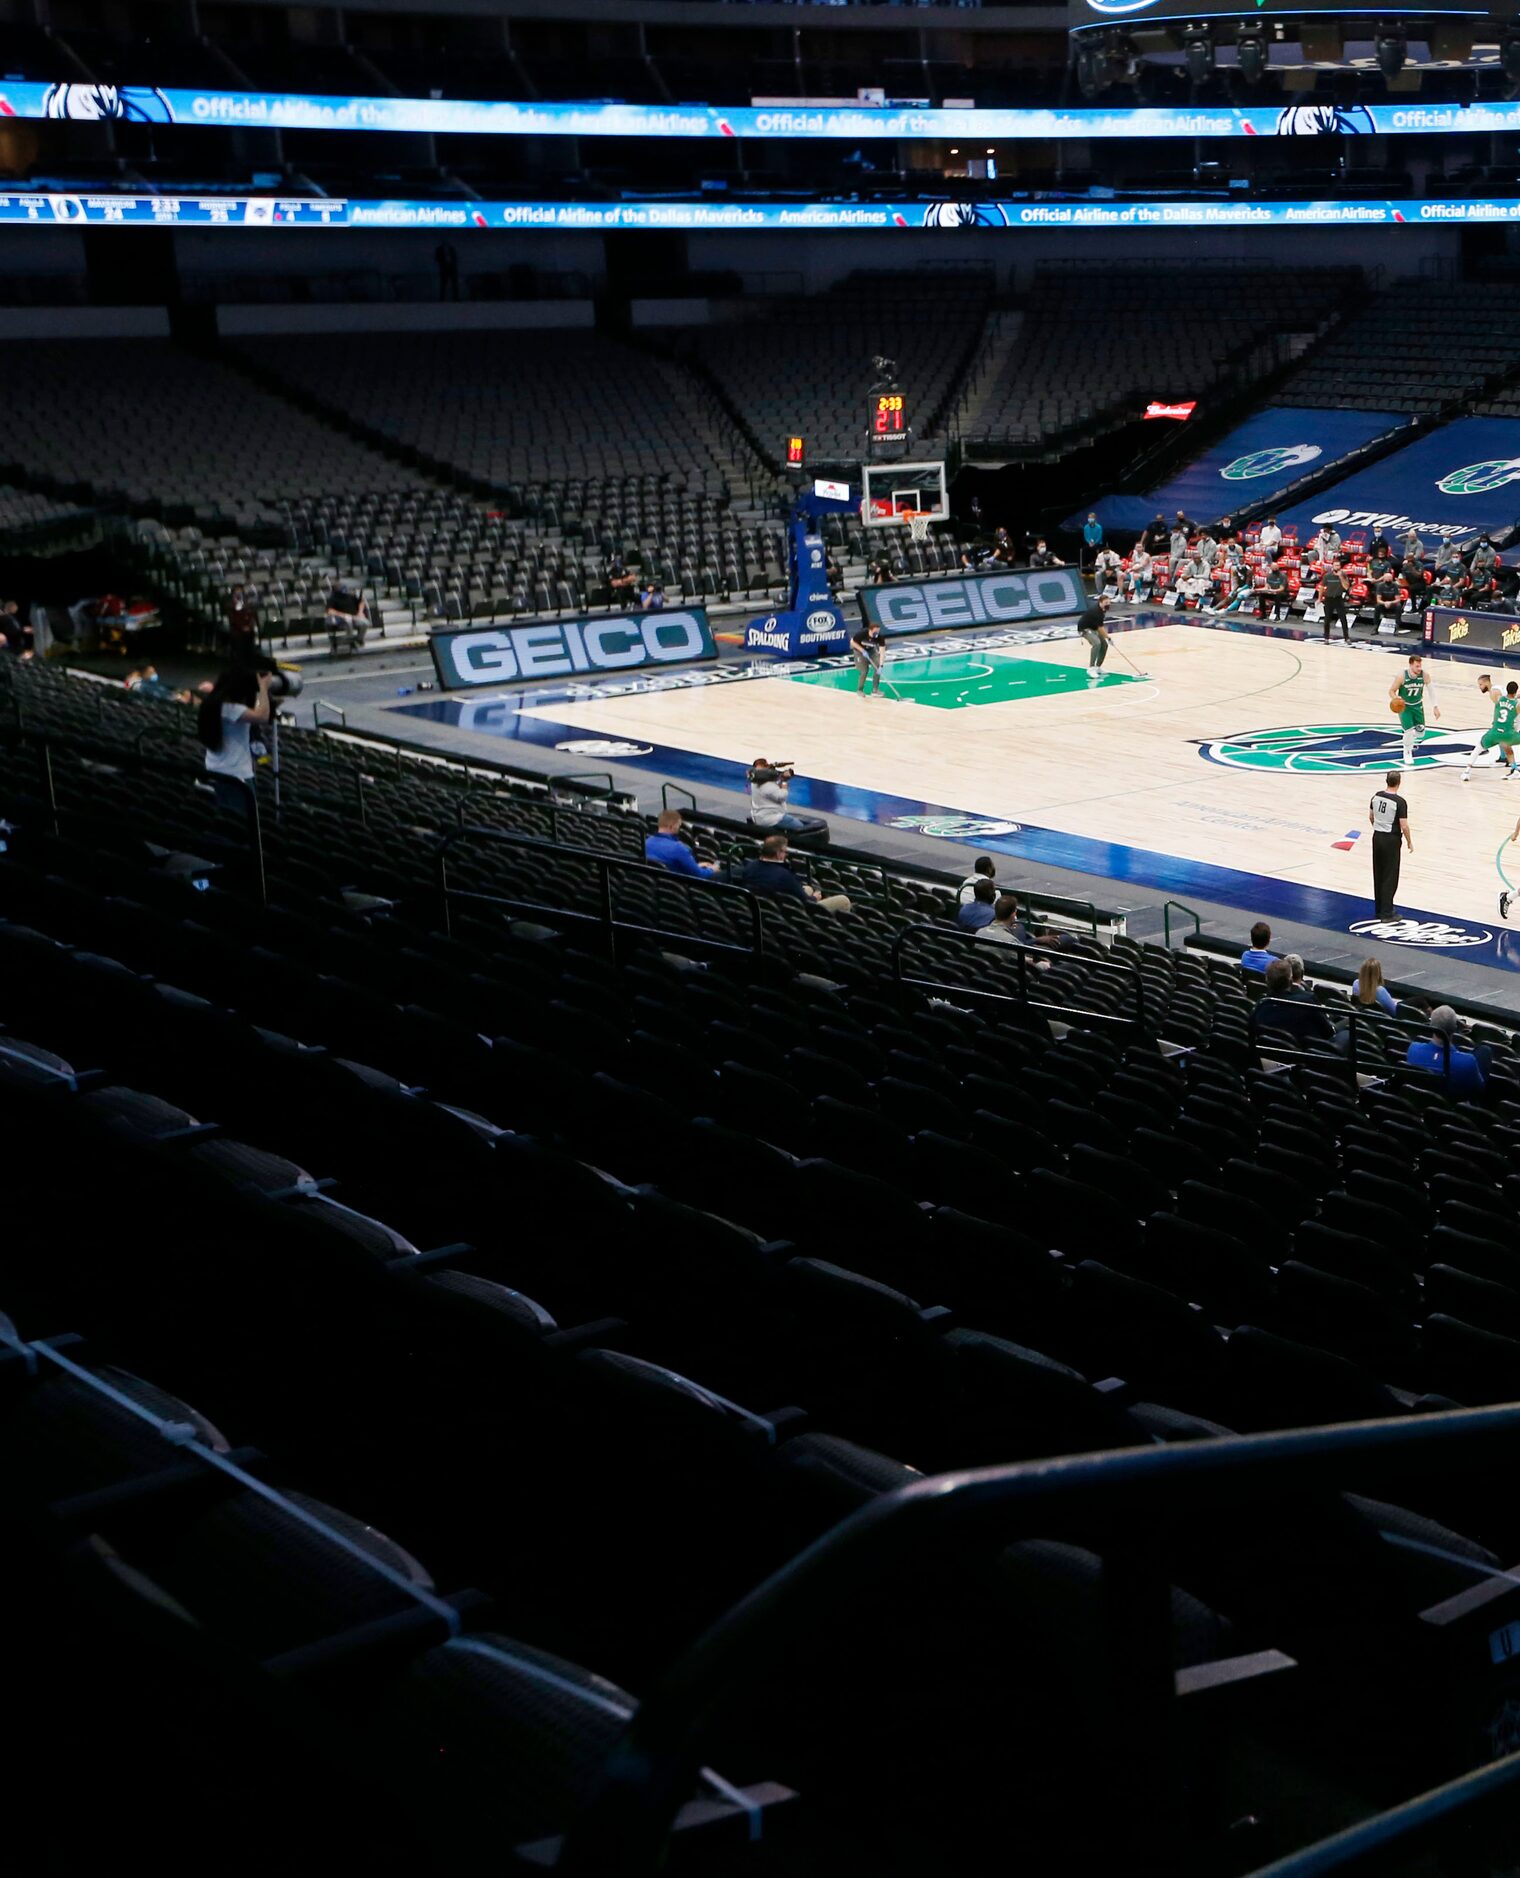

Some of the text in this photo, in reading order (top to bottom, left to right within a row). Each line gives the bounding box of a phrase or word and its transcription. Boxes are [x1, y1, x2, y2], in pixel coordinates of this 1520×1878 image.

[192, 97, 267, 119] Official
[756, 113, 823, 132] Official
[1393, 110, 1452, 128] Official
[417, 207, 467, 224] Airlines
[504, 207, 764, 224] Official Airline of the Dallas Mavericks
[779, 207, 886, 224] American Airlines
[1021, 204, 1271, 222] Official Airline of the Dallas Mavericks
[1285, 204, 1386, 220] American Airlines
[1420, 204, 1465, 219] Official
[1468, 203, 1507, 218] Airline
[879, 396, 903, 411] 2:33
[875, 409, 903, 433] 21
[883, 433, 907, 441] TISSOT
[876, 572, 1079, 634] GEICO
[747, 628, 790, 652] SPALDING
[799, 629, 846, 644] SOUTHWEST
[1448, 621, 1470, 644] Takis
[450, 611, 704, 685] GEICO
[1407, 687, 1420, 697] 77
[1497, 709, 1509, 723] 3
[1377, 800, 1388, 814] 18
